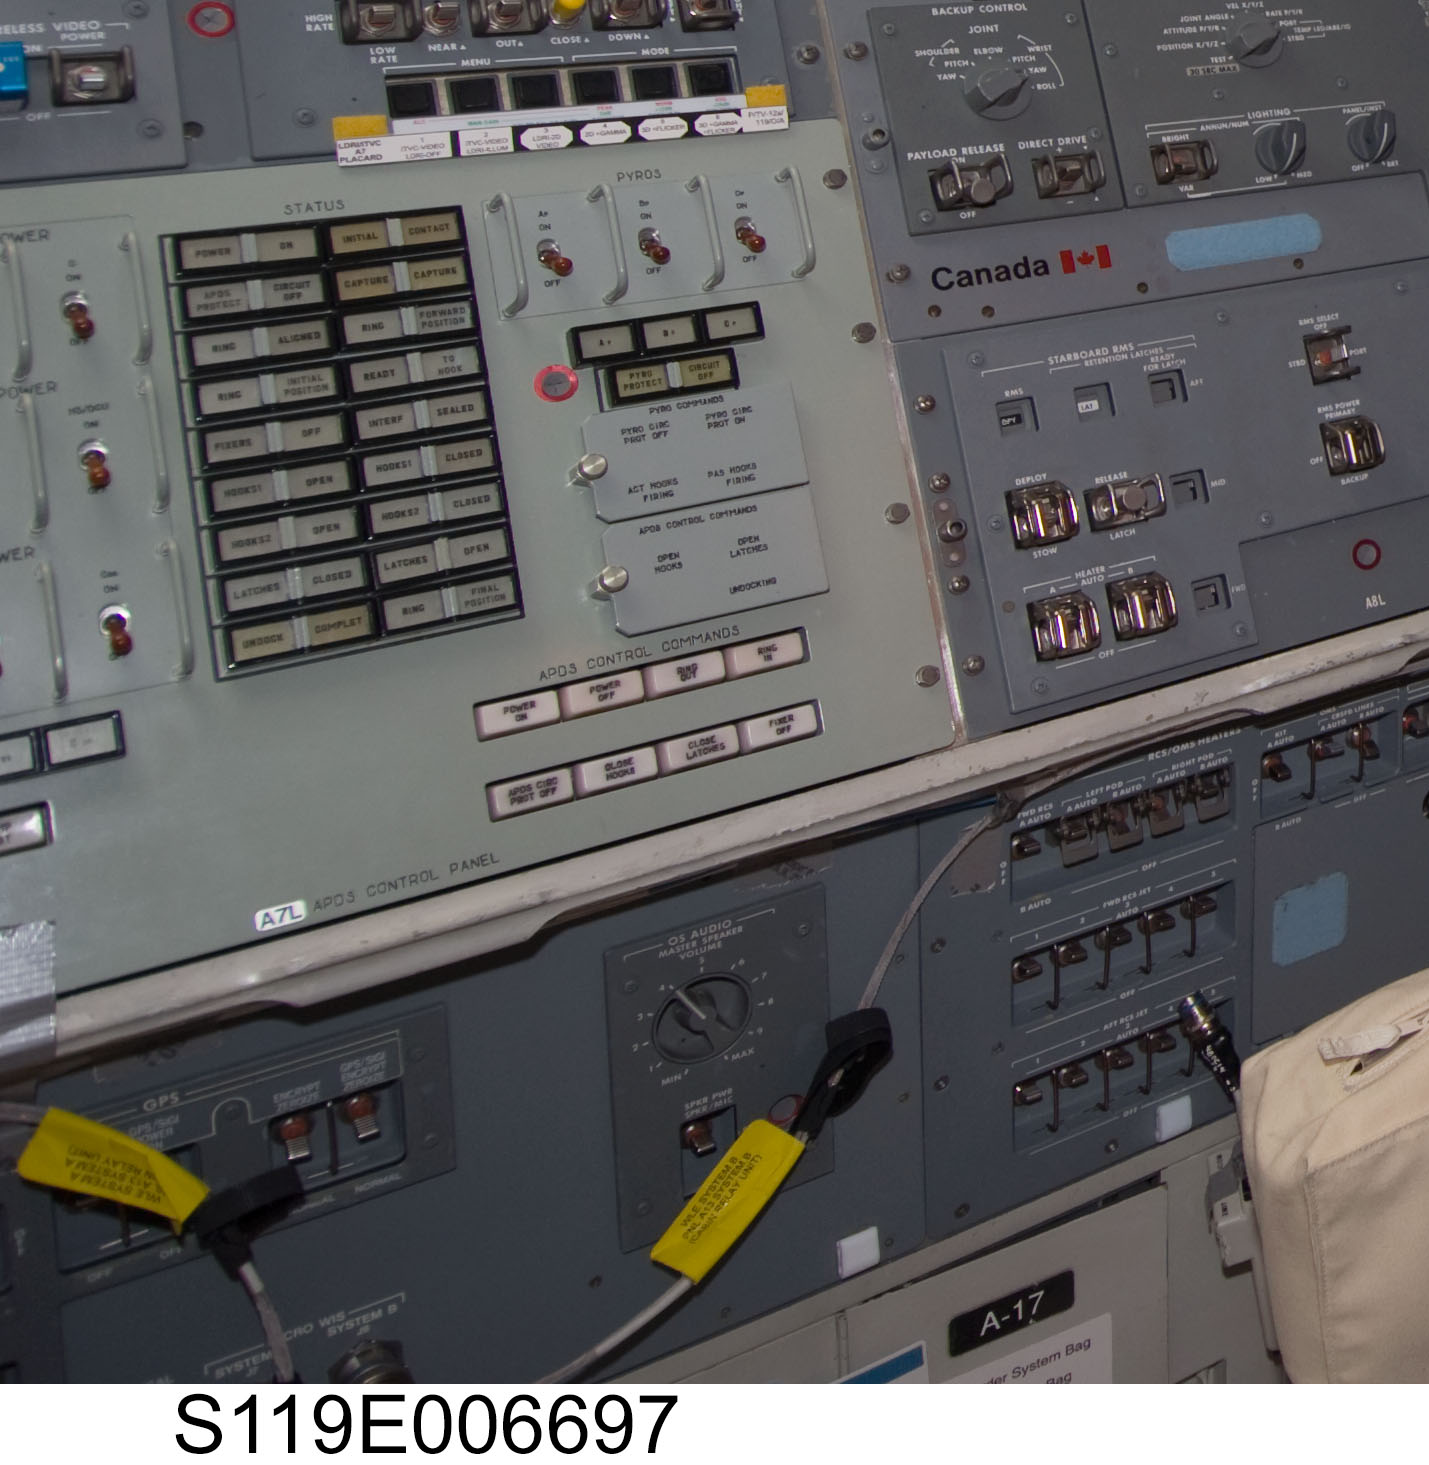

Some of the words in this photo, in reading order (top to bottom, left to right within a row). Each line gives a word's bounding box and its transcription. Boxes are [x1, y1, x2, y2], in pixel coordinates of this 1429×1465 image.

[931, 4, 974, 16] BACKUP
[979, 2, 1028, 14] CONTROL
[52, 20, 100, 32] VIDEO
[305, 13, 333, 25] HIGH
[305, 22, 335, 33] RATE
[968, 23, 1000, 35] JOINT
[60, 32, 106, 41] POWER
[428, 42, 459, 53] NEAR
[495, 39, 518, 49] OUT
[551, 35, 582, 46] CLOSE
[608, 31, 643, 42] DOWN
[370, 46, 396, 57] LOW
[461, 57, 491, 67] MENU
[641, 47, 670, 57] MODE
[914, 47, 960, 57] SHOULDER
[973, 46, 1003, 56] ELBOW
[1027, 44, 1053, 54] WRIST
[370, 55, 398, 65] RATE
[944, 59, 970, 69] PITCH
[1012, 54, 1037, 64] PITCH
[937, 73, 957, 81] YAW
[1028, 66, 1048, 75] YAW
[1036, 82, 1057, 91] ROLL
[26, 112, 50, 121] OFF
[1247, 108, 1291, 120] LIGHTING
[1200, 120, 1250, 132] ANNUN/NUM
[1018, 138, 1054, 151] DIRECT
[1058, 135, 1088, 147] DRIVE
[907, 148, 958, 162] PAYLOAD
[961, 143, 1006, 156] RELEASE
[617, 169, 662, 182] PYROS
[284, 199, 345, 217] STATUS
[960, 211, 976, 220] OFF
[343, 232, 378, 244] INITIAL
[408, 223, 450, 236] CONTACT
[344, 275, 389, 288] CAPTURE
[414, 266, 458, 279] CAPTURE
[931, 256, 1050, 291] Canada
[1298, 318, 1316, 327] RMS
[1317, 313, 1340, 324] SELECT
[212, 342, 237, 353] RING
[278, 331, 322, 344] ALIGNED
[361, 321, 385, 332] RING
[1047, 344, 1110, 366] STARBOARD
[1112, 342, 1135, 355] RMS
[1084, 353, 1129, 368] RETENTION
[217, 391, 242, 402] RING
[363, 369, 395, 382] READY
[623, 377, 663, 392] PROTECT
[1003, 387, 1024, 398] RMS
[1317, 403, 1334, 414] RMS
[1336, 399, 1361, 411] POWER
[1325, 408, 1356, 420] PRIMARY
[367, 415, 403, 428] INTERF
[436, 403, 474, 417] SEALED
[446, 448, 483, 462] CLOSED
[306, 475, 333, 487] OPEN
[1015, 472, 1047, 486] DEPLOY
[1095, 471, 1129, 485] RELEASE
[1340, 473, 1369, 486] BACKUP
[453, 494, 491, 509] CLOSED
[1032, 547, 1058, 560] STOW
[1109, 528, 1136, 541] LATCH
[384, 555, 429, 571] LATCHES
[464, 543, 490, 556] OPEN
[1075, 565, 1106, 579] HEATER
[233, 583, 281, 600] LATCHES
[1365, 593, 1387, 610] A8L
[402, 603, 426, 616] RING
[539, 662, 578, 682] APDS
[586, 646, 652, 669] CONTROL
[661, 625, 741, 653] COMMANDS
[503, 700, 537, 716] POWER
[1148, 740, 1196, 762] RCS/OMS
[312, 890, 356, 914] APDS
[366, 868, 440, 898] CONTROL
[448, 852, 501, 876] PANEL
[259, 904, 303, 930] A7L
[667, 932, 687, 947] OS
[690, 919, 733, 939] AUDIO
[658, 939, 698, 960] MASTER
[702, 925, 744, 944] SPEAKER
[679, 940, 724, 961] VOLUME
[731, 1047, 756, 1063] MAX
[661, 1074, 683, 1087] MIN
[143, 1092, 180, 1112] GPS
[980, 1289, 1046, 1336] A-17
[1011, 1351, 1061, 1380] System
[1065, 1337, 1092, 1357] Bag
